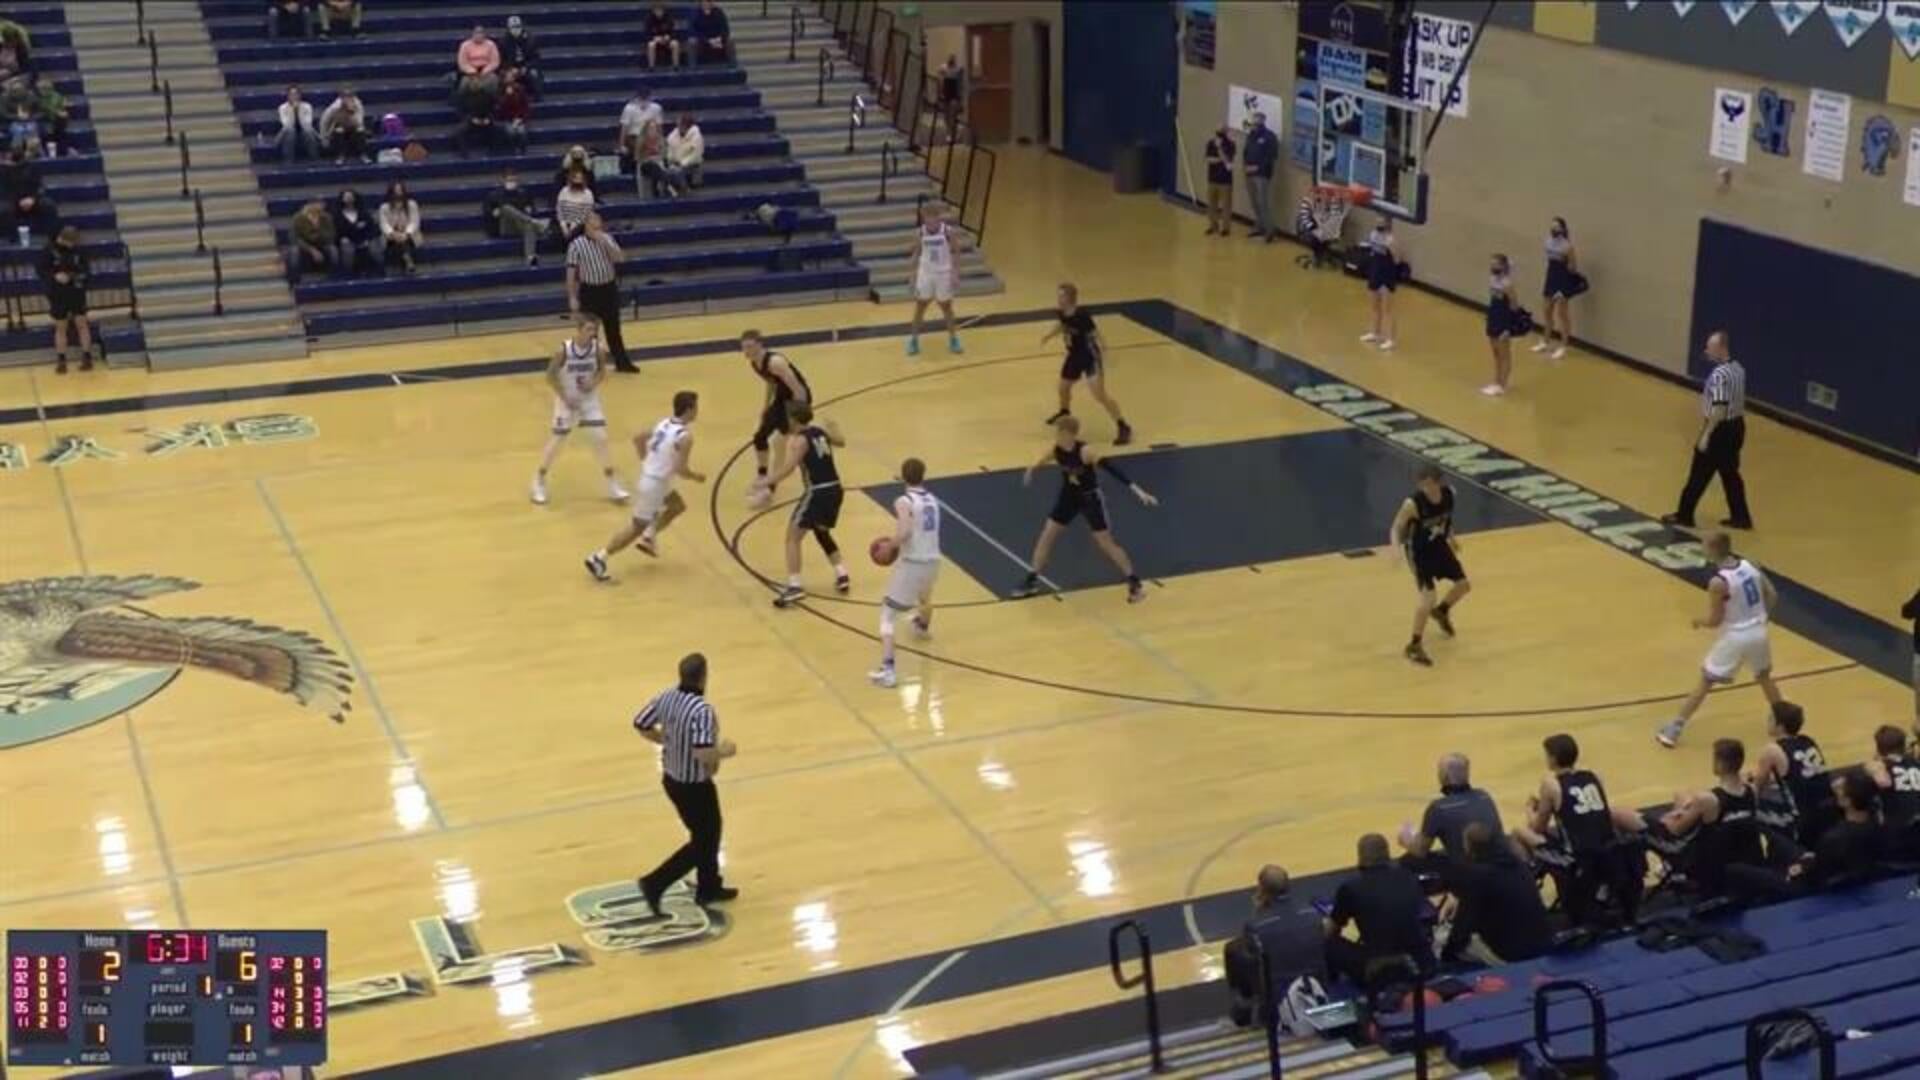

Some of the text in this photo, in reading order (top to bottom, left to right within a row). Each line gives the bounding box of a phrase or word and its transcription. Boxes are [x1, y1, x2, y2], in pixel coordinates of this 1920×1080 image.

[1447, 23, 1471, 49] UP
[1294, 383, 1527, 477] SALEM
[1488, 473, 1709, 571] HILLS
